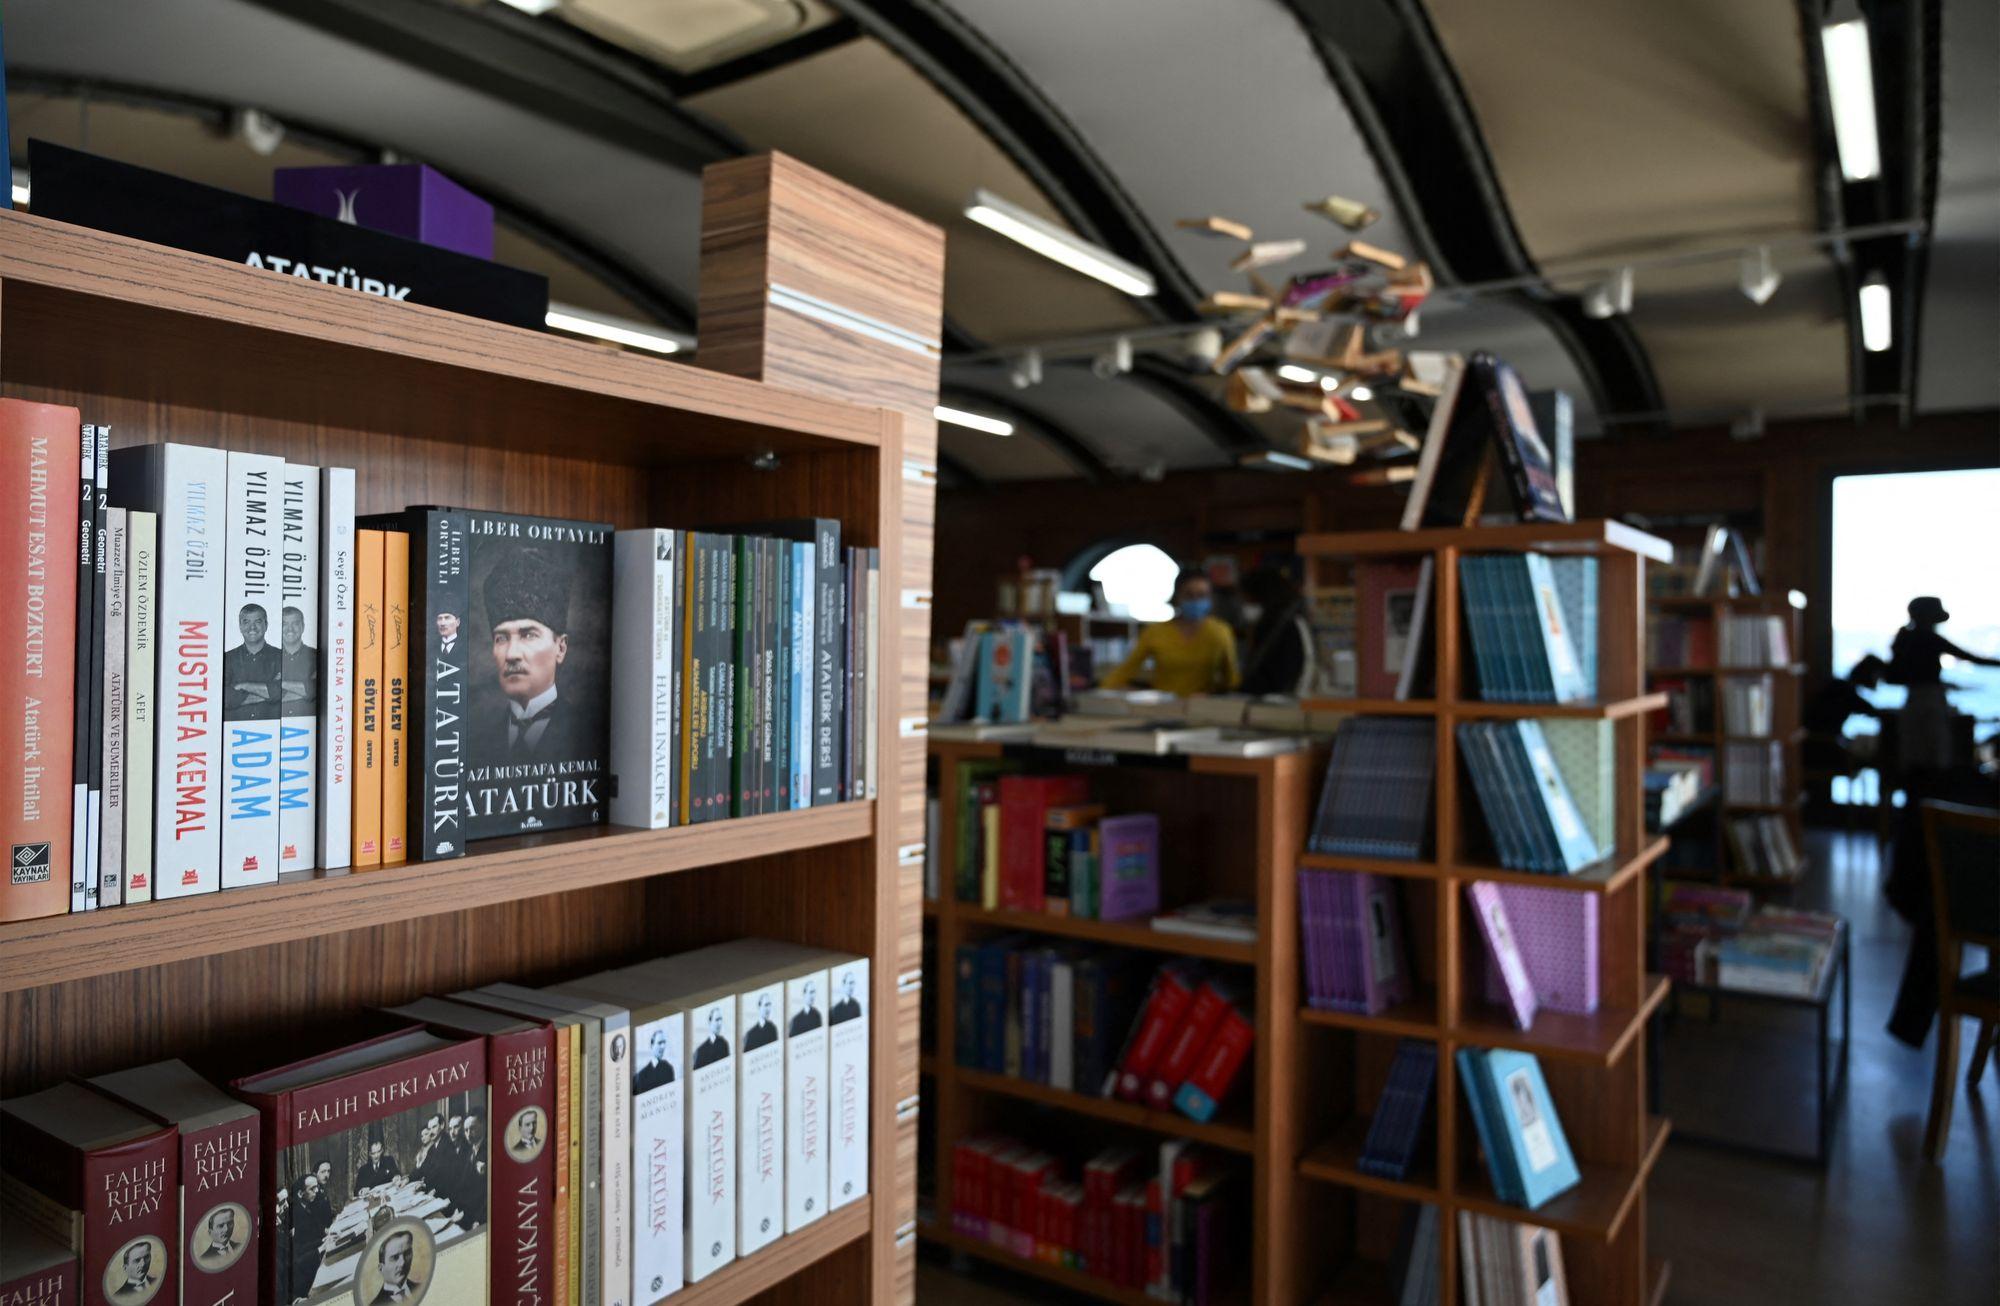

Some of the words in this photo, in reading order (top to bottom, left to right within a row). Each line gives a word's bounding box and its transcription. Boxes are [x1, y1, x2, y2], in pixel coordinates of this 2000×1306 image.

[245, 251, 411, 302] ATATÜRK
[29, 437, 48, 528] MAHMUT
[82, 484, 92, 501] 2
[99, 493, 107, 510] 2
[246, 471, 267, 536] YILMAZ
[186, 482, 207, 533] YILMAZ
[283, 481, 304, 542] YILMAZ
[28, 531, 46, 579] ESAT
[81, 519, 92, 566] Geometri
[97, 529, 107, 574] Geometri
[113, 527, 124, 568] Muazzez
[439, 519, 449, 584] ORTAYLI
[528, 525, 607, 545] ORTAYLI
[138, 550, 149, 591] ÖZLEM
[186, 538, 208, 581] ÖZDİL
[244, 546, 271, 598] ÖZDİL
[282, 552, 307, 601] ÖZDİL
[335, 551, 347, 581] Sevgi
[111, 569, 124, 599] İlmiye
[336, 584, 348, 611] Özel
[26, 584, 45, 678] BOZKURT
[111, 600, 123, 617] Çığ
[137, 595, 149, 651] ÖZDEMİR
[176, 620, 209, 742] MUSTAFA
[335, 638, 345, 687] BENİM
[110, 671, 122, 722] ATATÜRK
[136, 692, 146, 722] AFET
[364, 678, 377, 732] SÖYLEV
[391, 677, 403, 732] SÖYLEV
[820, 649, 833, 724] ATATÜRK
[23, 696, 43, 760] Atatürk
[110, 724, 120, 738] VE
[334, 694, 346, 785] ATATÜRKÜM
[433, 658, 465, 834] ATATÜRK
[820, 727, 832, 768] DERSİ
[230, 729, 273, 820] ADAM
[280, 726, 310, 810] ADAM
[495, 762, 556, 780] MUSTAFA
[559, 759, 600, 775] KEMAL
[23, 766, 45, 822] İhtilali
[175, 752, 207, 841] KEMAL
[465, 777, 599, 818] ATATÜRK
[13, 864, 49, 877] KAYNAK
[13, 873, 50, 884] YAYINLARI
[298, 1096, 358, 1130] FALİH
[367, 1077, 418, 1108] RIFKI
[426, 1061, 471, 1091] ATAY
[507, 1061, 546, 1083] RIFKI
[508, 1074, 545, 1096] ATAY
[194, 1129, 250, 1160] FALİH
[197, 1147, 249, 1176] RIFKI
[711, 1109, 726, 1205] ATATÜRK
[104, 1157, 166, 1191] FALİH
[107, 1176, 164, 1209] RIFKI
[197, 1163, 248, 1192] ATAY
[652, 1136, 668, 1237] ATATÜRK
[108, 1194, 163, 1226] ATAY
